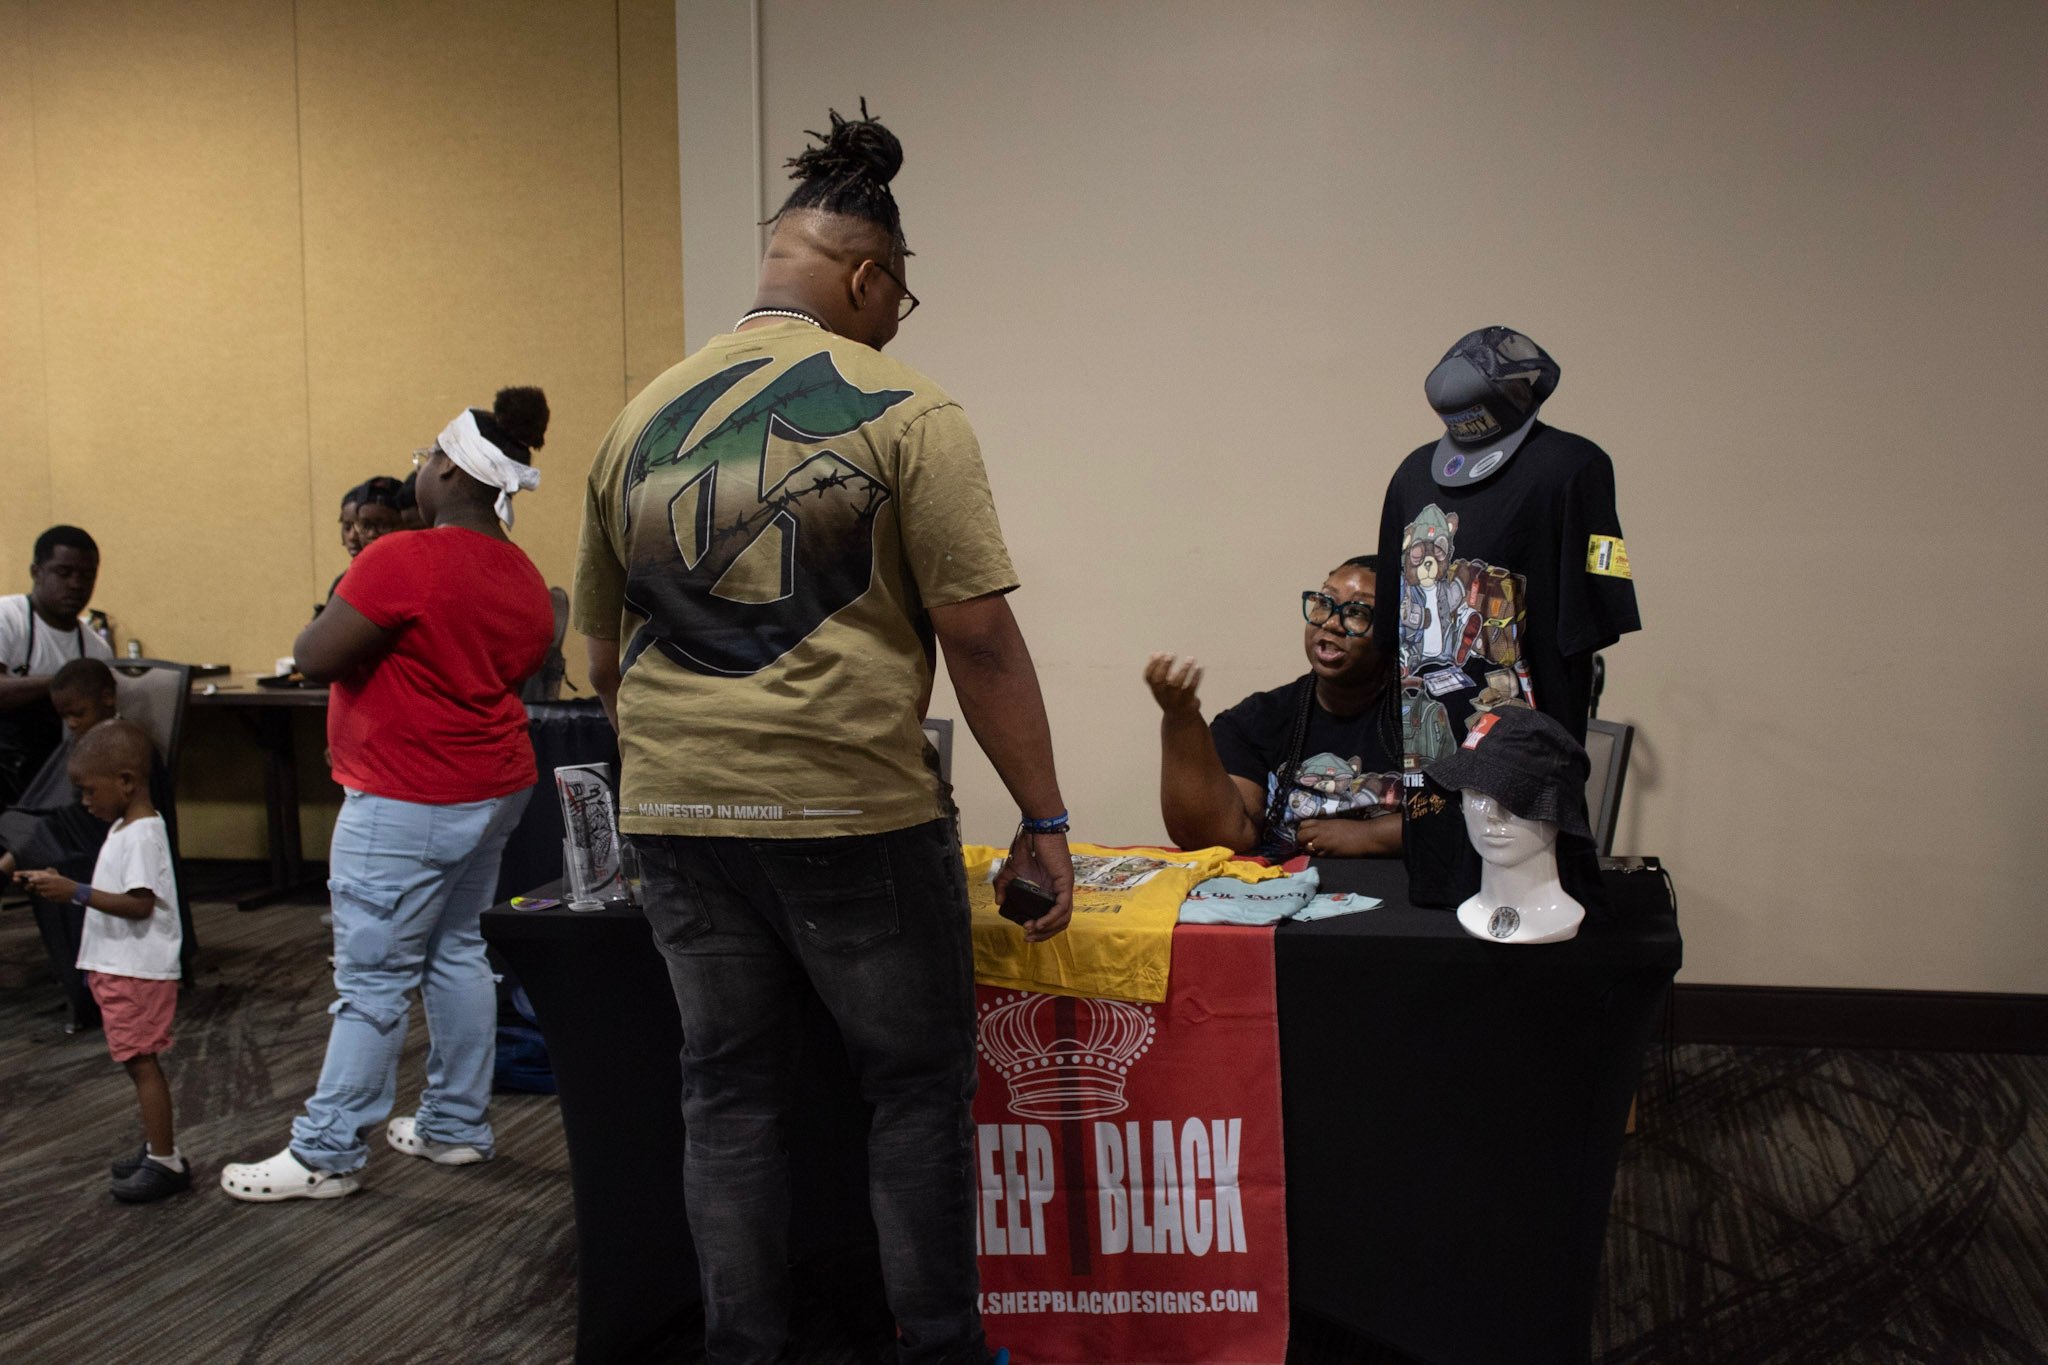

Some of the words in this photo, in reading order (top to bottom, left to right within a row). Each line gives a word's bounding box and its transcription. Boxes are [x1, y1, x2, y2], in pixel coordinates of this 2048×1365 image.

[638, 803, 714, 819] MANIFESTED
[717, 805, 732, 818] IN
[734, 805, 783, 820] MMXIII
[976, 1123, 1055, 1256] EEP
[1094, 1116, 1248, 1257] BLACK
[977, 1289, 1259, 1315] .SHEEPBLACKDESIGNS.COM
